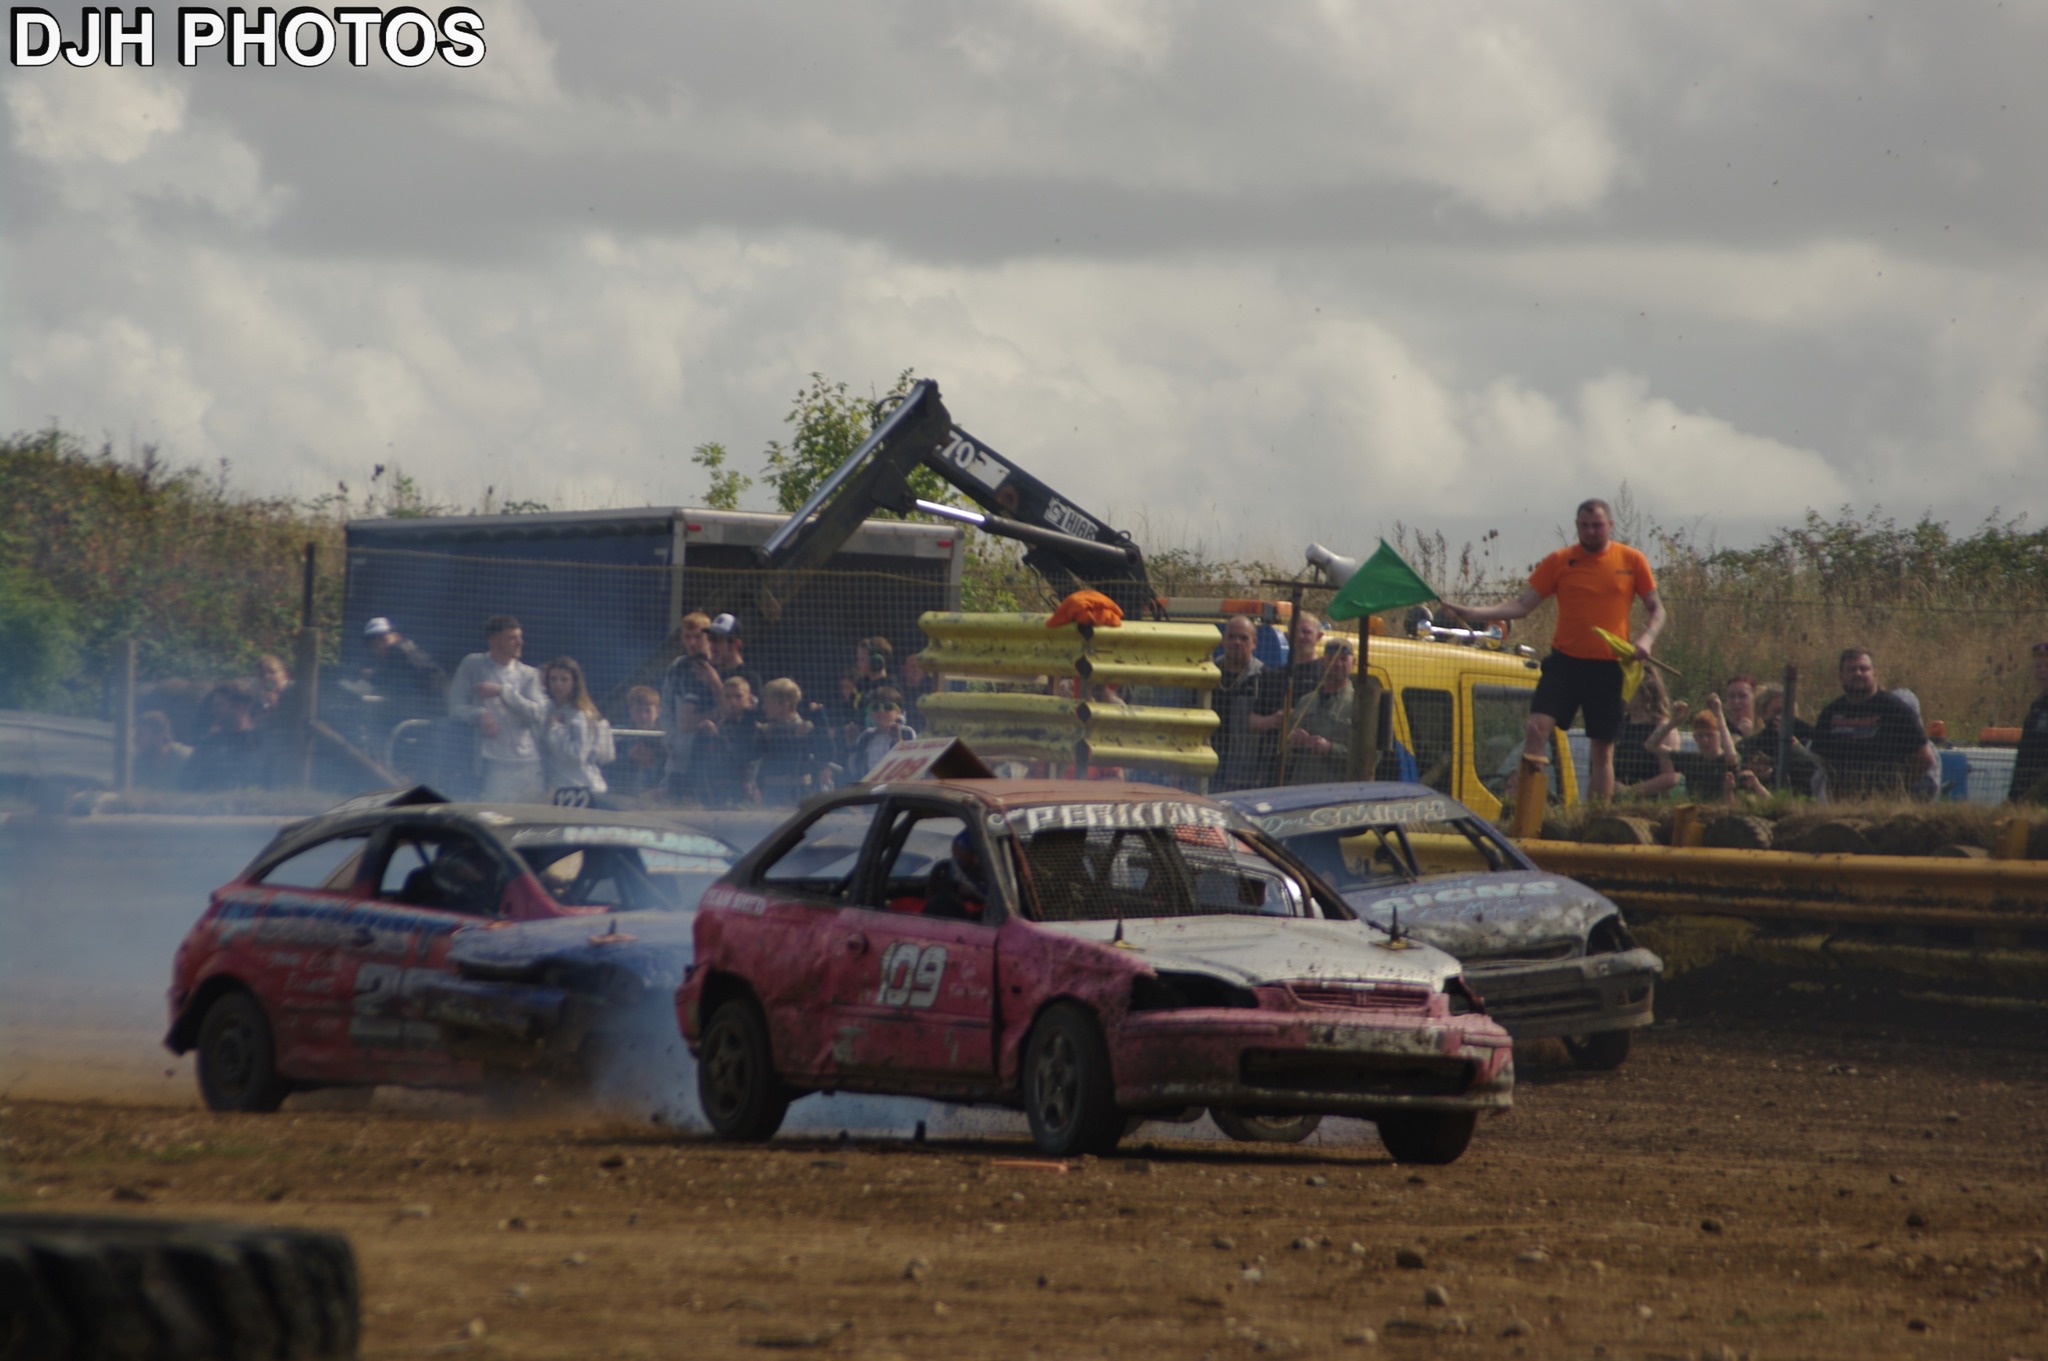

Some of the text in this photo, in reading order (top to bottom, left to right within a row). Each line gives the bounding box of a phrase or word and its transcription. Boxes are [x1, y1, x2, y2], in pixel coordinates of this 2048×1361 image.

[869, 756, 930, 783] 109
[1027, 802, 1228, 833] PERKINS
[1306, 799, 1446, 828] SMITH
[1370, 880, 1561, 915] SIGNS
[876, 940, 949, 1011] 109
